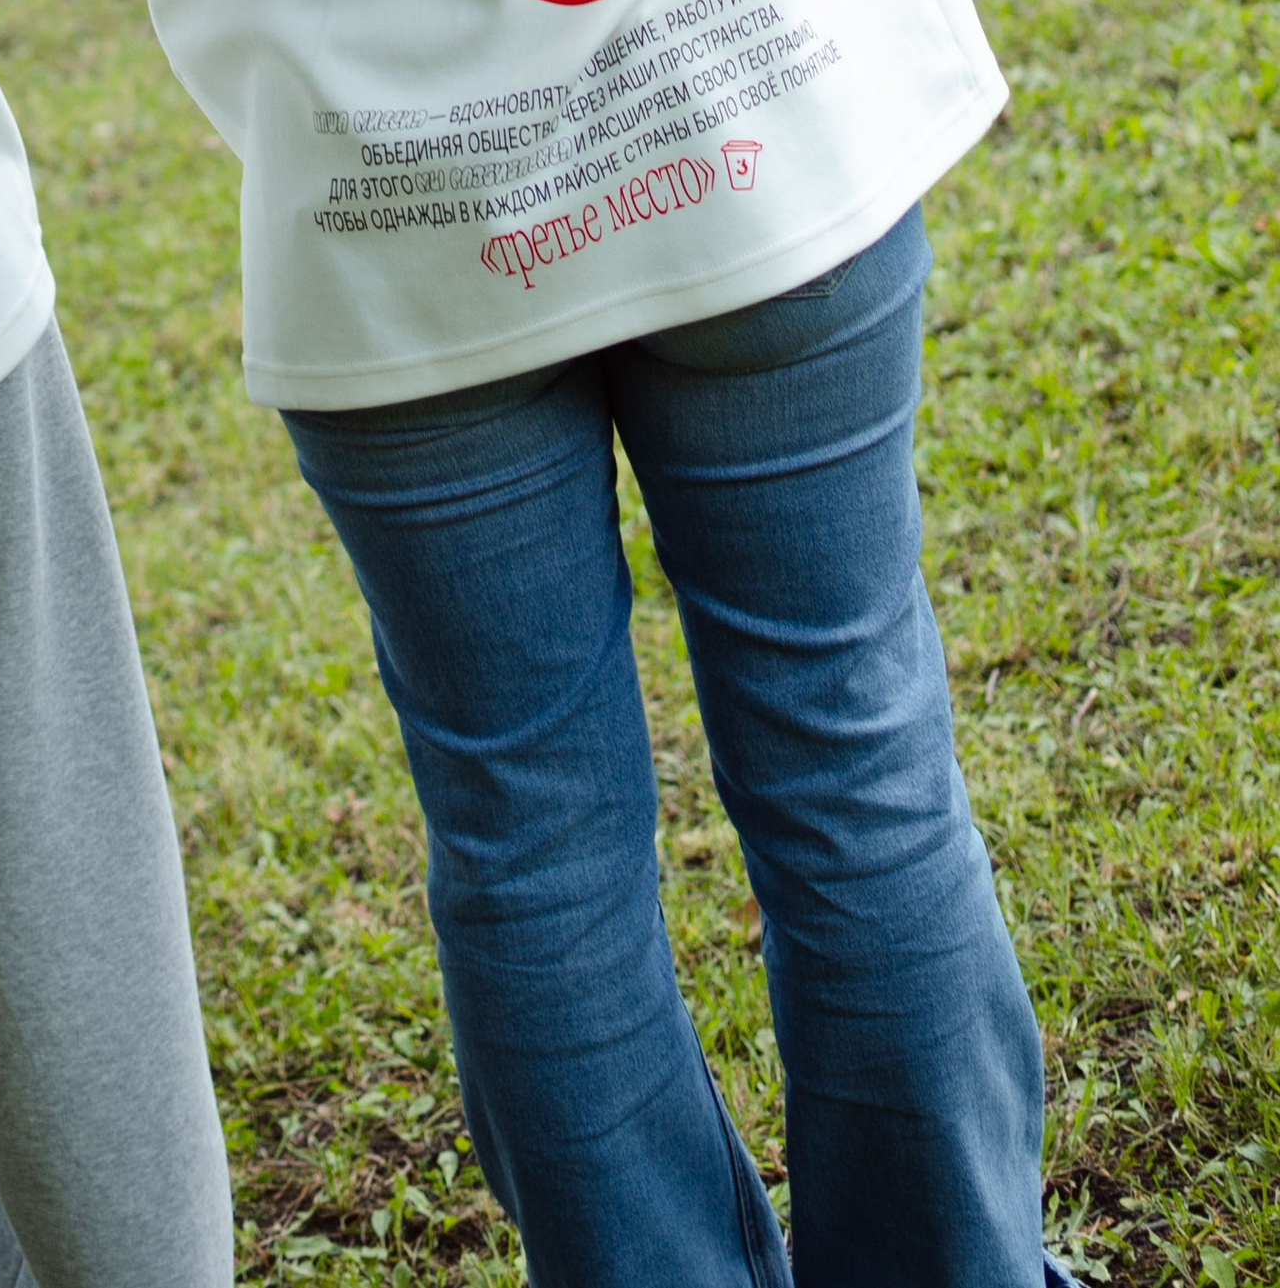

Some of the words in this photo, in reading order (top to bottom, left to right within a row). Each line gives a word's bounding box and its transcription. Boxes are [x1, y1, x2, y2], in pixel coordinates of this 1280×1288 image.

[314, 209, 369, 233] ЧТОБЫ
[370, 201, 457, 233] ОДНАЖДЫ
[460, 203, 470, 224] В
[473, 180, 553, 222] КАЖДОМ
[554, 152, 622, 199] РАЙОНЕ
[623, 124, 692, 164] СТРАНЫ
[692, 96, 739, 135] БЫЛО
[739, 71, 782, 112] СВОЁ
[780, 38, 842, 92] ПОНЯТНОЕ
[329, 178, 357, 205] ДЛЯ
[360, 174, 414, 201] ЭТОГО
[574, 132, 587, 156] И
[588, 85, 692, 148] РАСШИРЯЕМ
[692, 59, 738, 98] СВОЮ
[361, 133, 463, 168] ОБЪЕДИНЯЯ
[468, 115, 559, 160] ОБЩЕСТВО
[560, 87, 606, 125] ЧЕРЕЗ
[607, 62, 657, 102] НАШИ
[658, 3, 785, 75] ПРОСТРАНСТВА.
